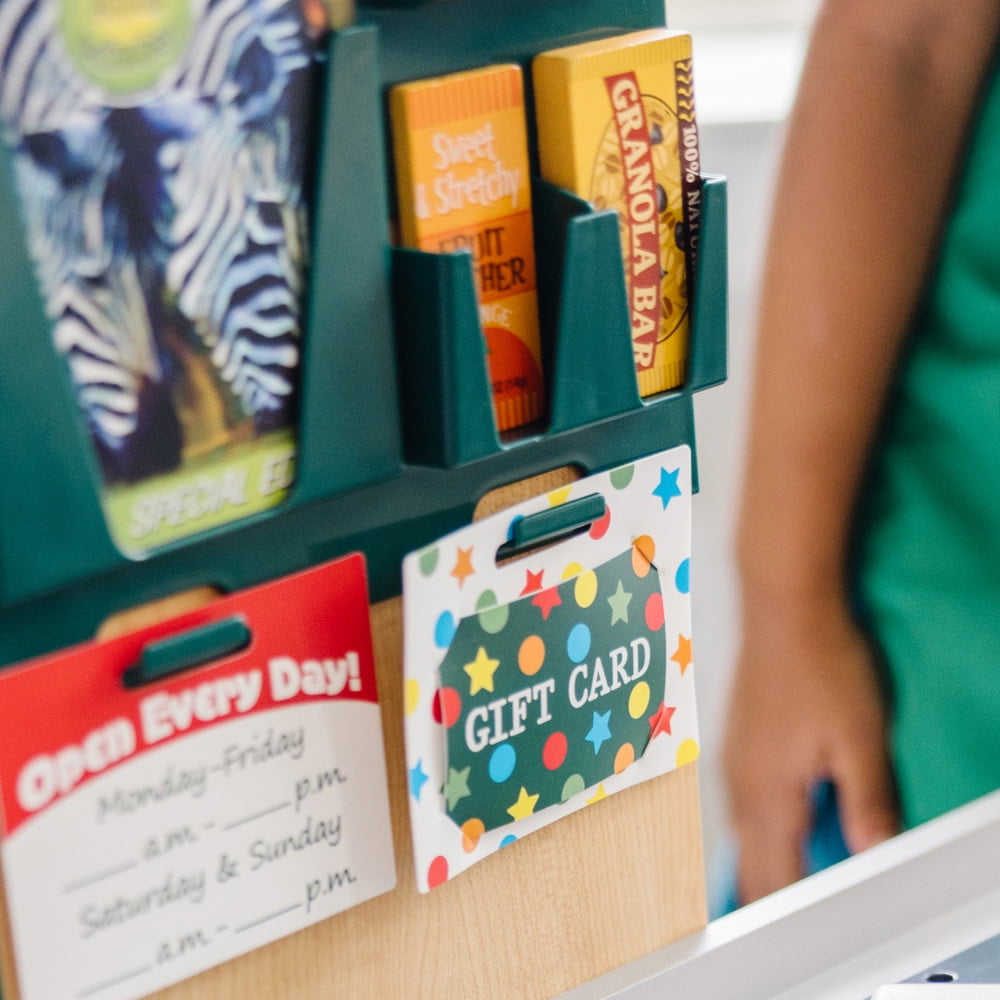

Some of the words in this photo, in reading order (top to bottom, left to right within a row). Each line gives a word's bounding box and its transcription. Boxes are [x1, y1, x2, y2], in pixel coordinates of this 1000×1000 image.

[433, 122, 497, 172] Sweet
[433, 160, 521, 216] Stretchy
[611, 78, 655, 277] GRANOLA
[683, 122, 700, 184] 100%
[632, 285, 658, 370] BAR
[130, 469, 247, 538] SPECIAL
[15, 717, 137, 813] Open
[139, 668, 263, 745] Every
[267, 651, 362, 702] Day!
[464, 677, 556, 753] GIFT
[567, 636, 651, 709] CARD
[78, 869, 206, 941] Saturday
[216, 853, 240, 884] &
[249, 814, 343, 872] Sunday
